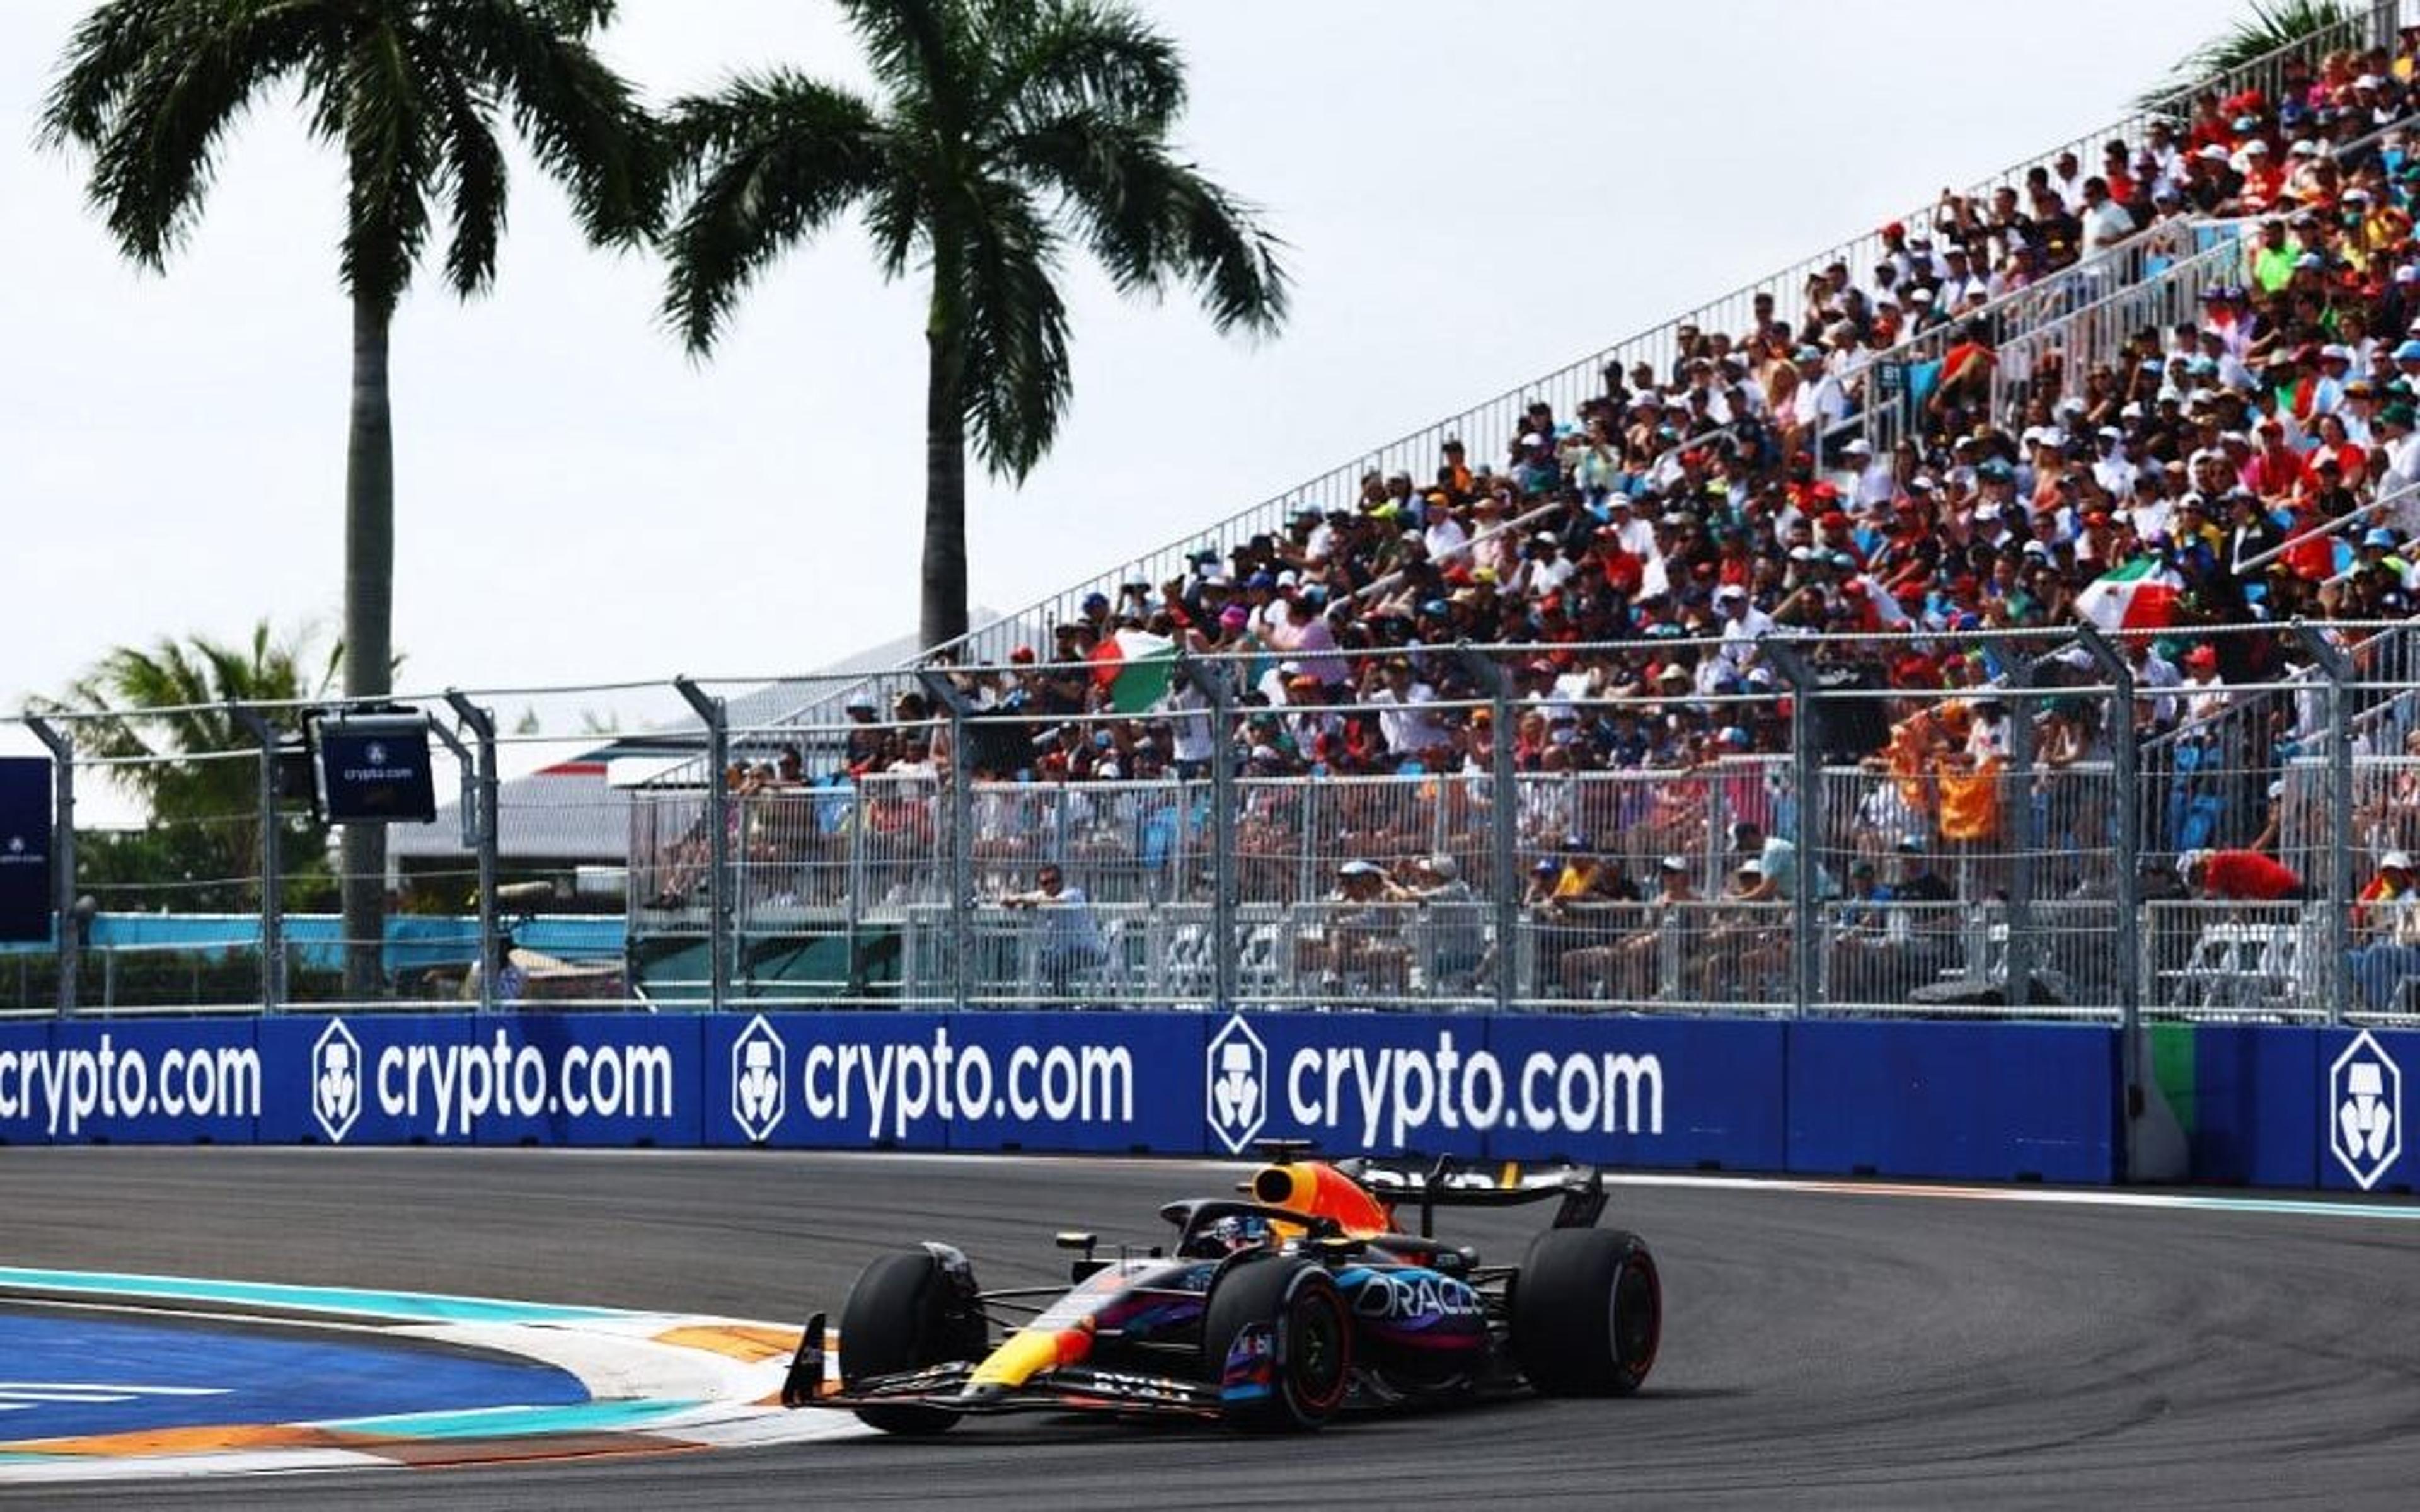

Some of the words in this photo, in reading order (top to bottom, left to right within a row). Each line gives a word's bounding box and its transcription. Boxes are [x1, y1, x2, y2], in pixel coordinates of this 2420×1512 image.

[0, 1034, 261, 1135] crypto.com
[377, 1028, 672, 1136] crypto.com
[804, 1026, 1133, 1139] crypto.com
[1288, 1031, 1664, 1148] crypto.com
